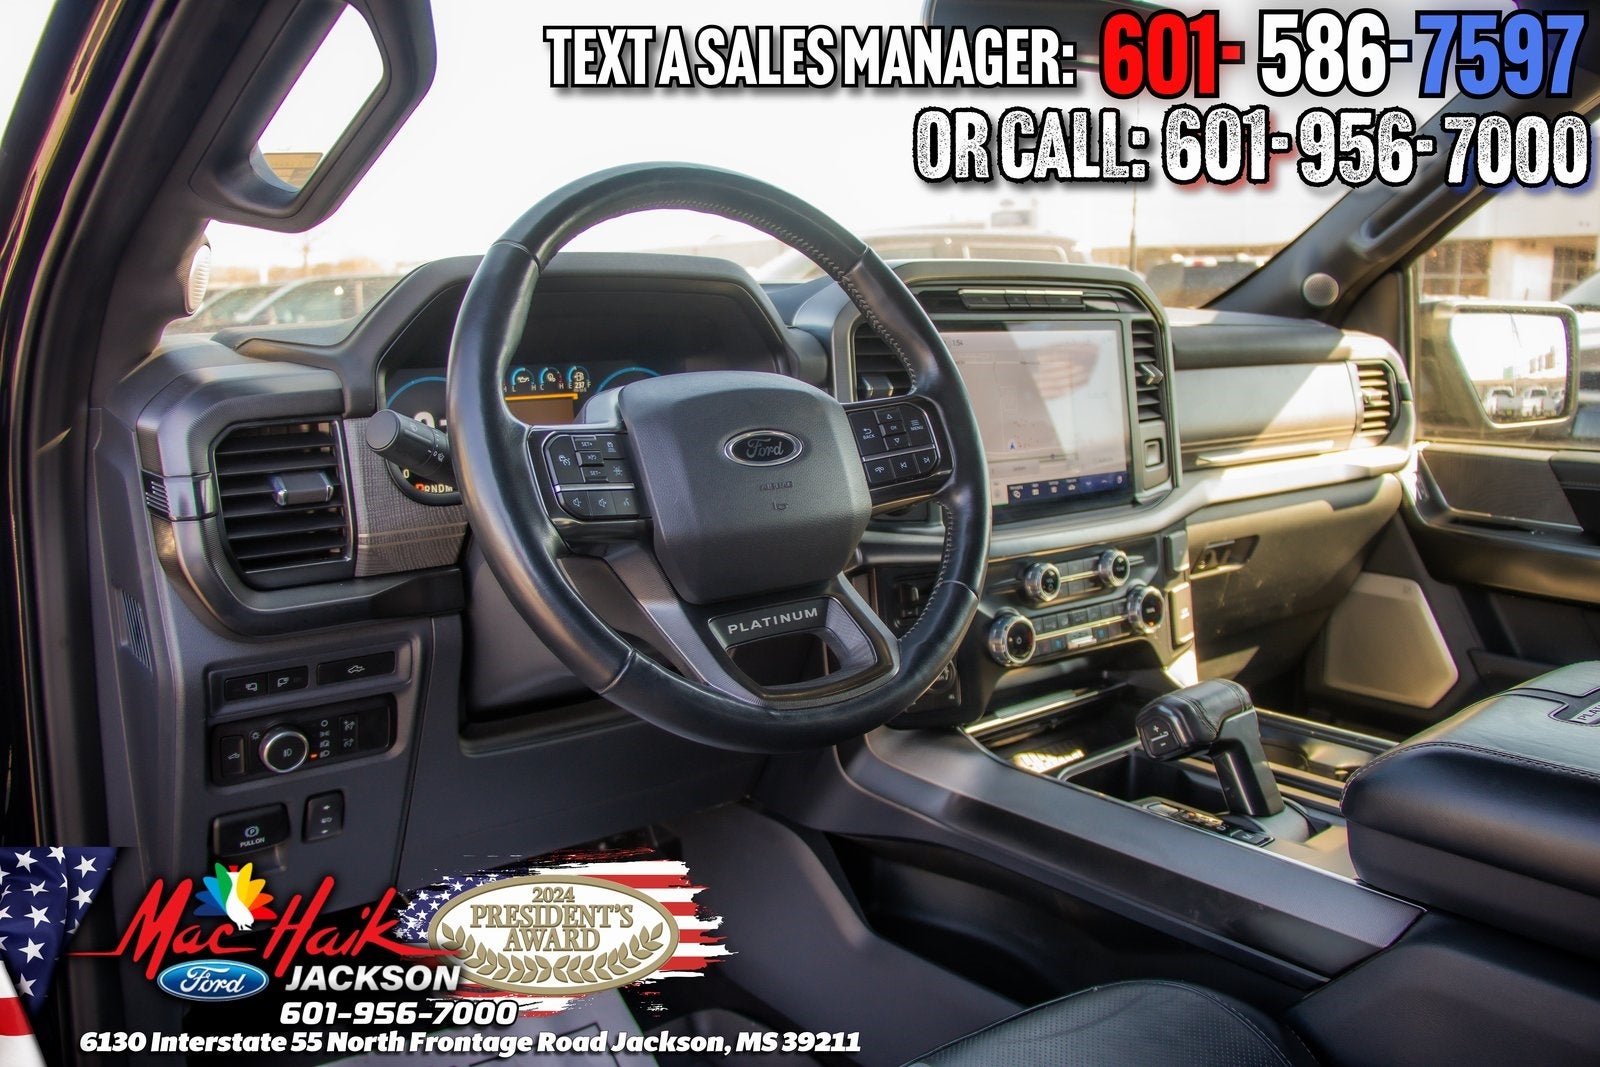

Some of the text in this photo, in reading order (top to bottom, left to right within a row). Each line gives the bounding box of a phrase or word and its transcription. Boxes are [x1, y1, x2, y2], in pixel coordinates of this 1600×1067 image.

[746, 438, 784, 458] Ford
[727, 607, 819, 635] PLATINUM
[240, 840, 255, 848] PULL
